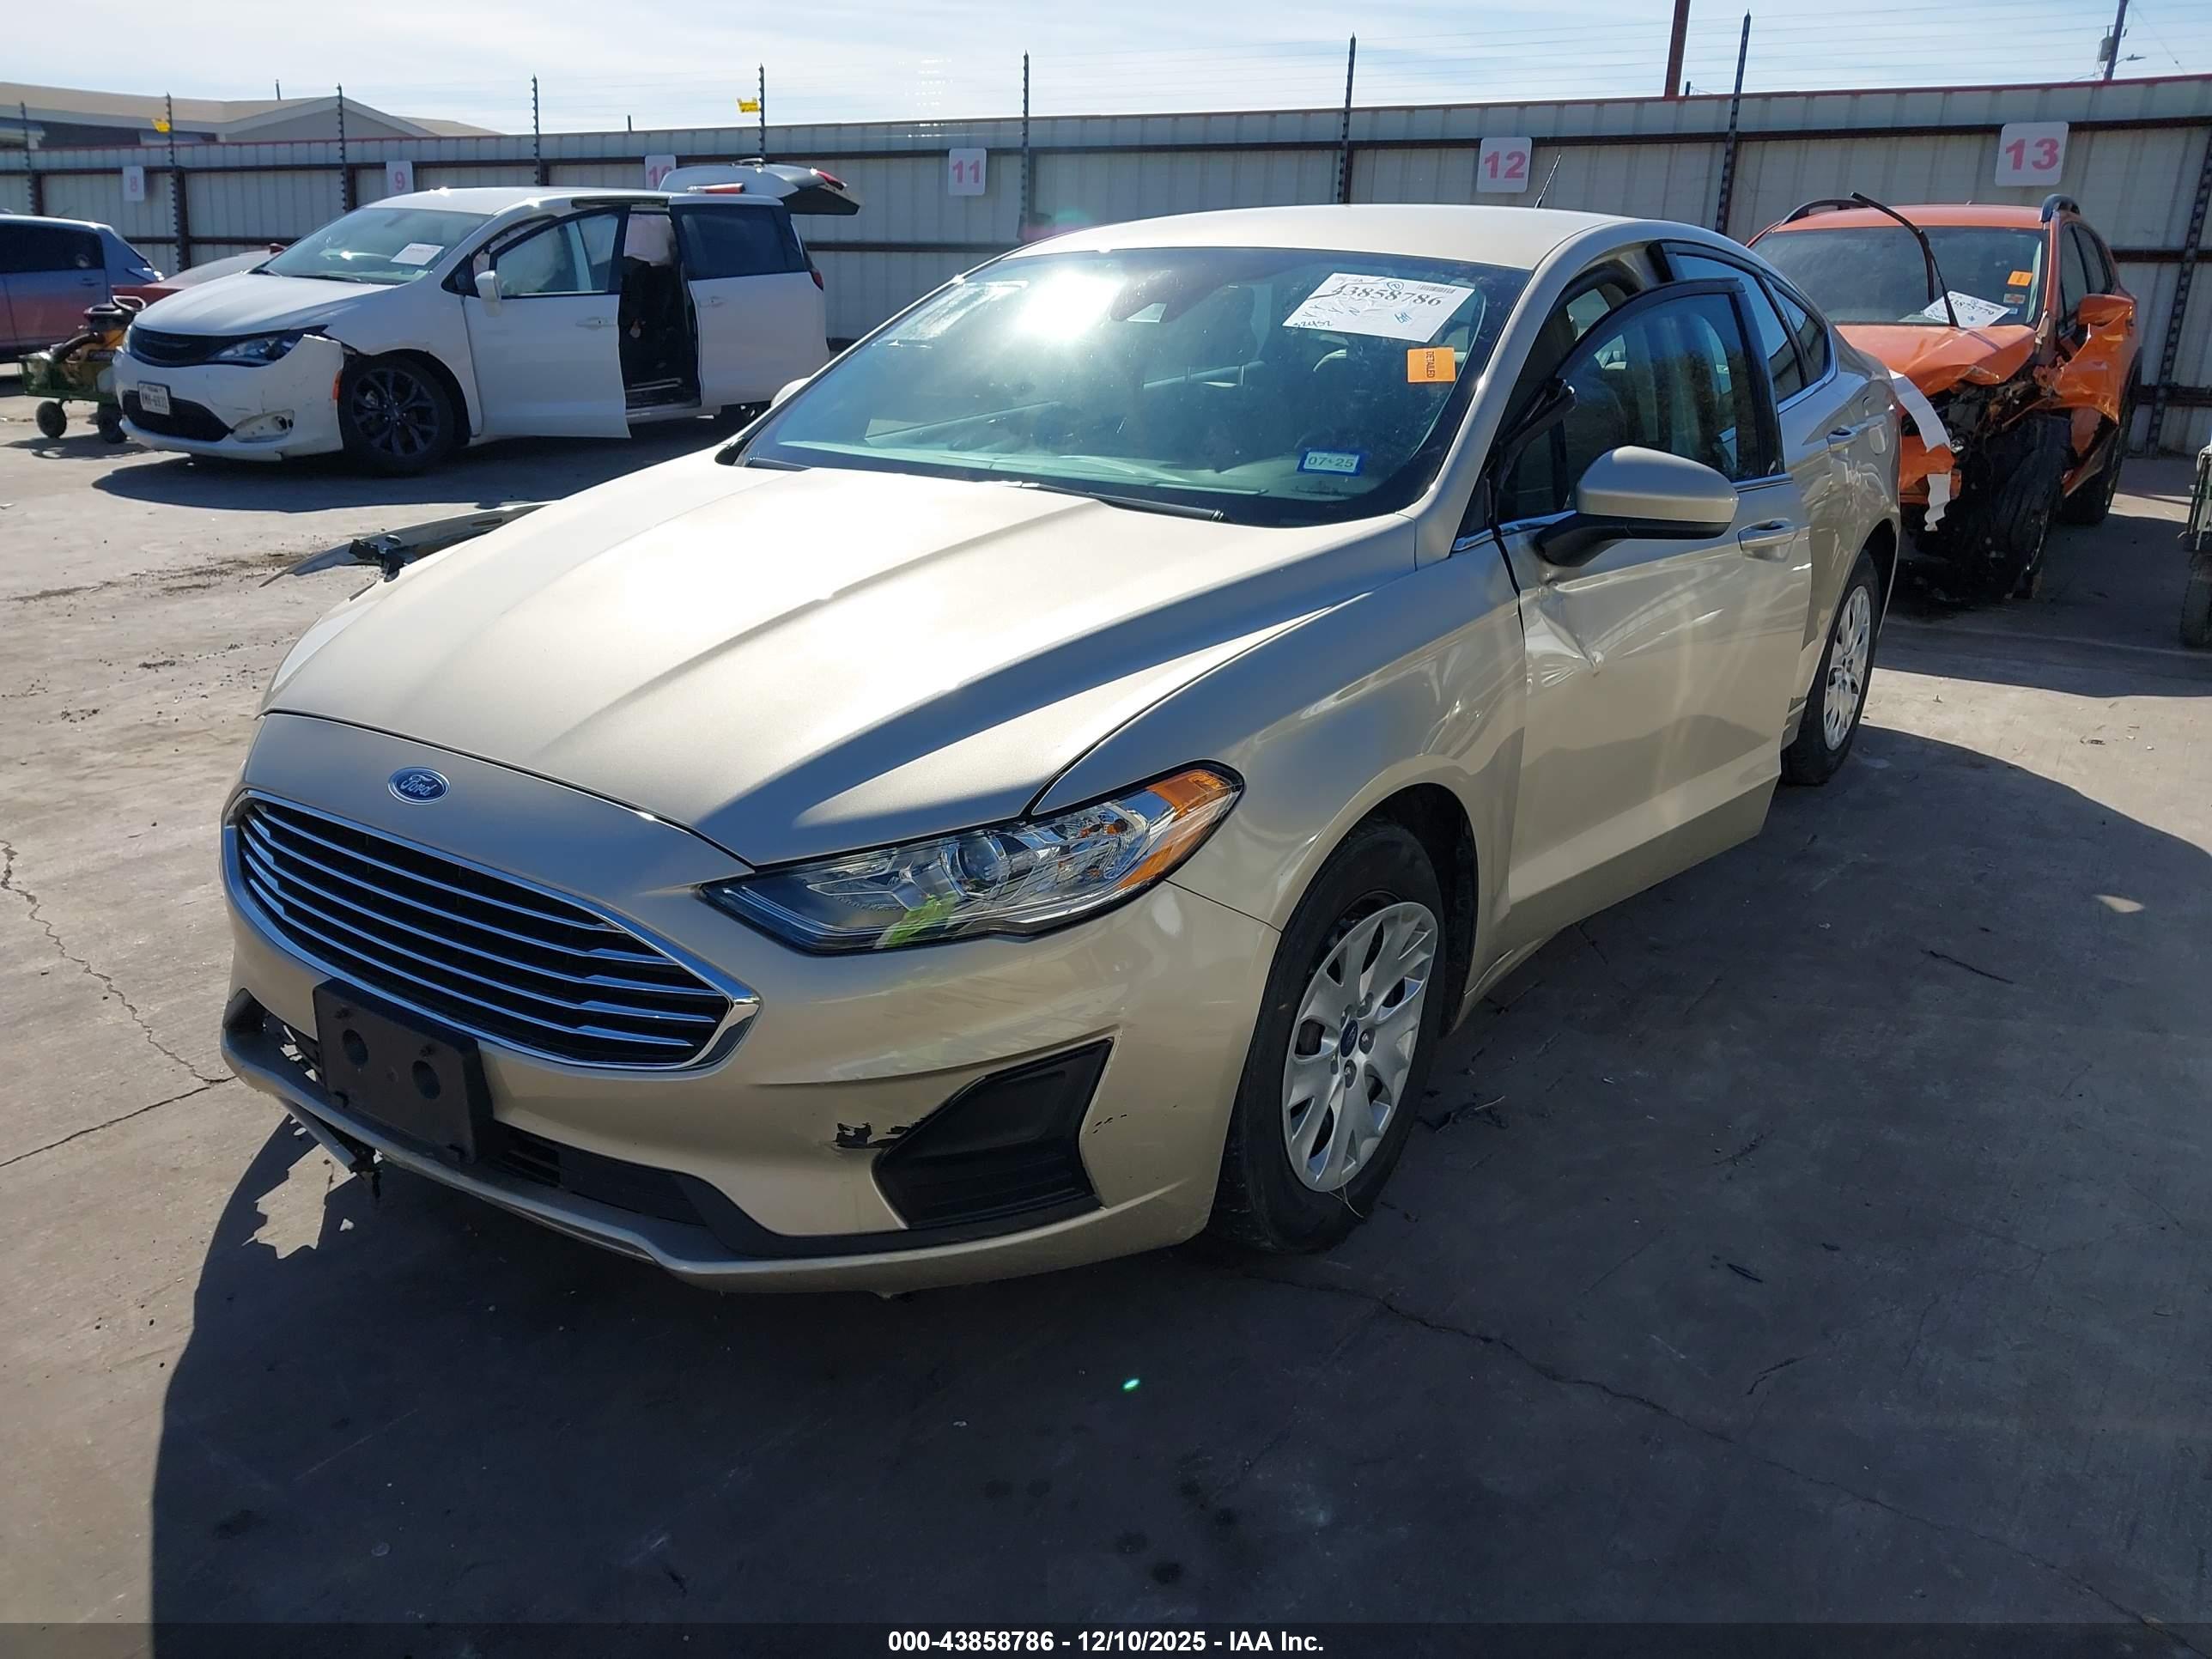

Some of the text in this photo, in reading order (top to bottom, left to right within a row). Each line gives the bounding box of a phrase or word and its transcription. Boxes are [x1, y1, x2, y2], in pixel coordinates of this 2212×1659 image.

[1484, 150, 1527, 179] 12
[2005, 137, 2059, 170] 13
[130, 175, 138, 192] 8
[395, 171, 406, 191] 9
[952, 159, 981, 184] 11
[1425, 350, 1436, 378] DETAILED
[399, 774, 438, 797] Ford
